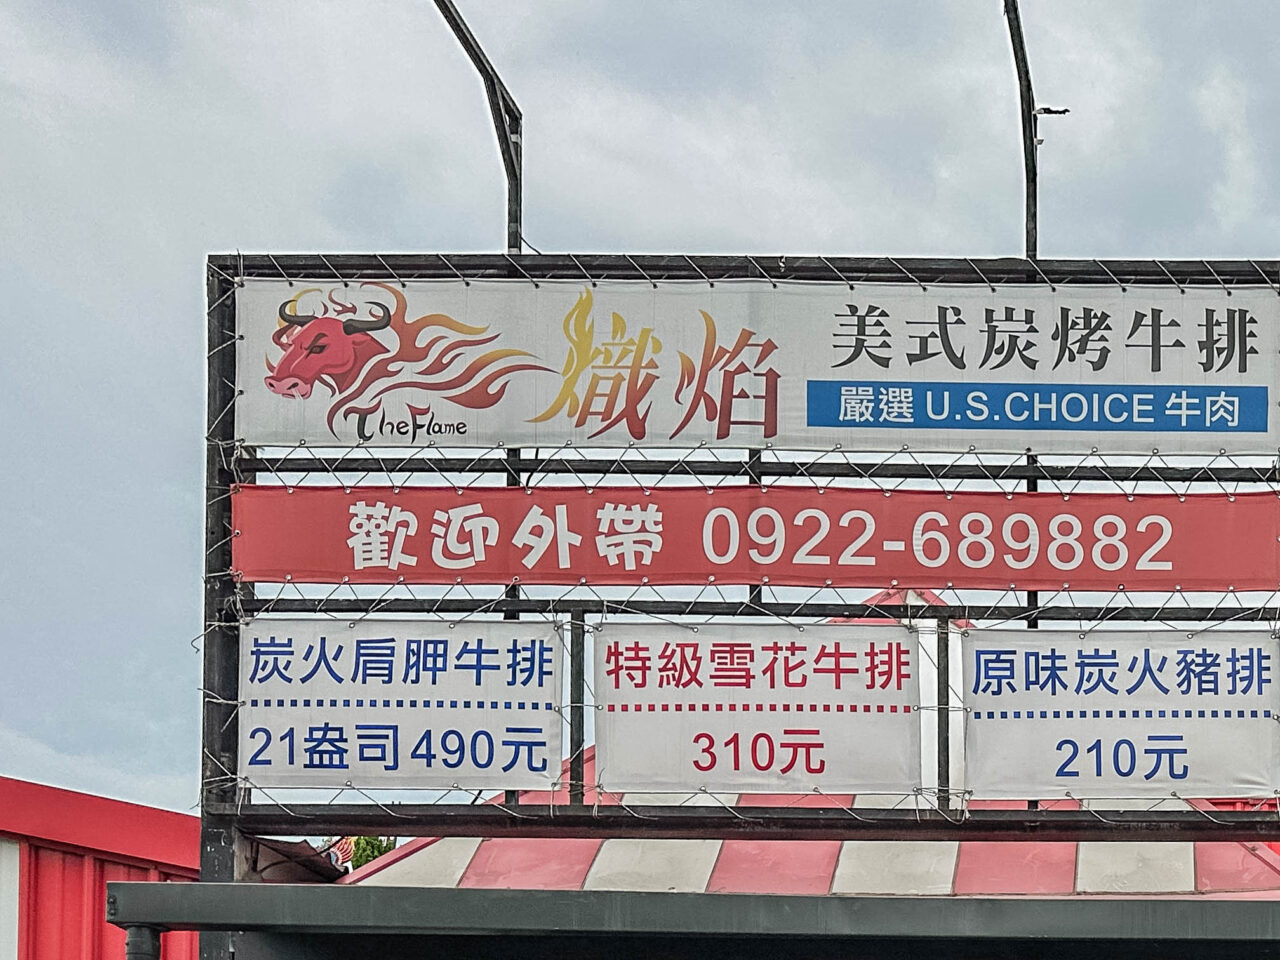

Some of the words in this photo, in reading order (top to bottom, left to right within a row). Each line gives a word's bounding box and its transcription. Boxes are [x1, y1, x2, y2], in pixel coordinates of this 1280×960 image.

[526, 285, 781, 440] 熾焰
[832, 303, 1258, 373] 美式炭烤牛排
[838, 385, 914, 423] 嚴選
[1164, 391, 1240, 427] 牛肉
[346, 501, 664, 571] 歡迎外帶
[702, 506, 1174, 572] 0922-689882
[249, 637, 553, 688] 炭火肩胛牛排
[605, 641, 911, 691] 特級雪花牛排
[972, 647, 1272, 697] 原味炭火豬排
[692, 729, 826, 774] 310元
[1055, 734, 1189, 780] 210元
